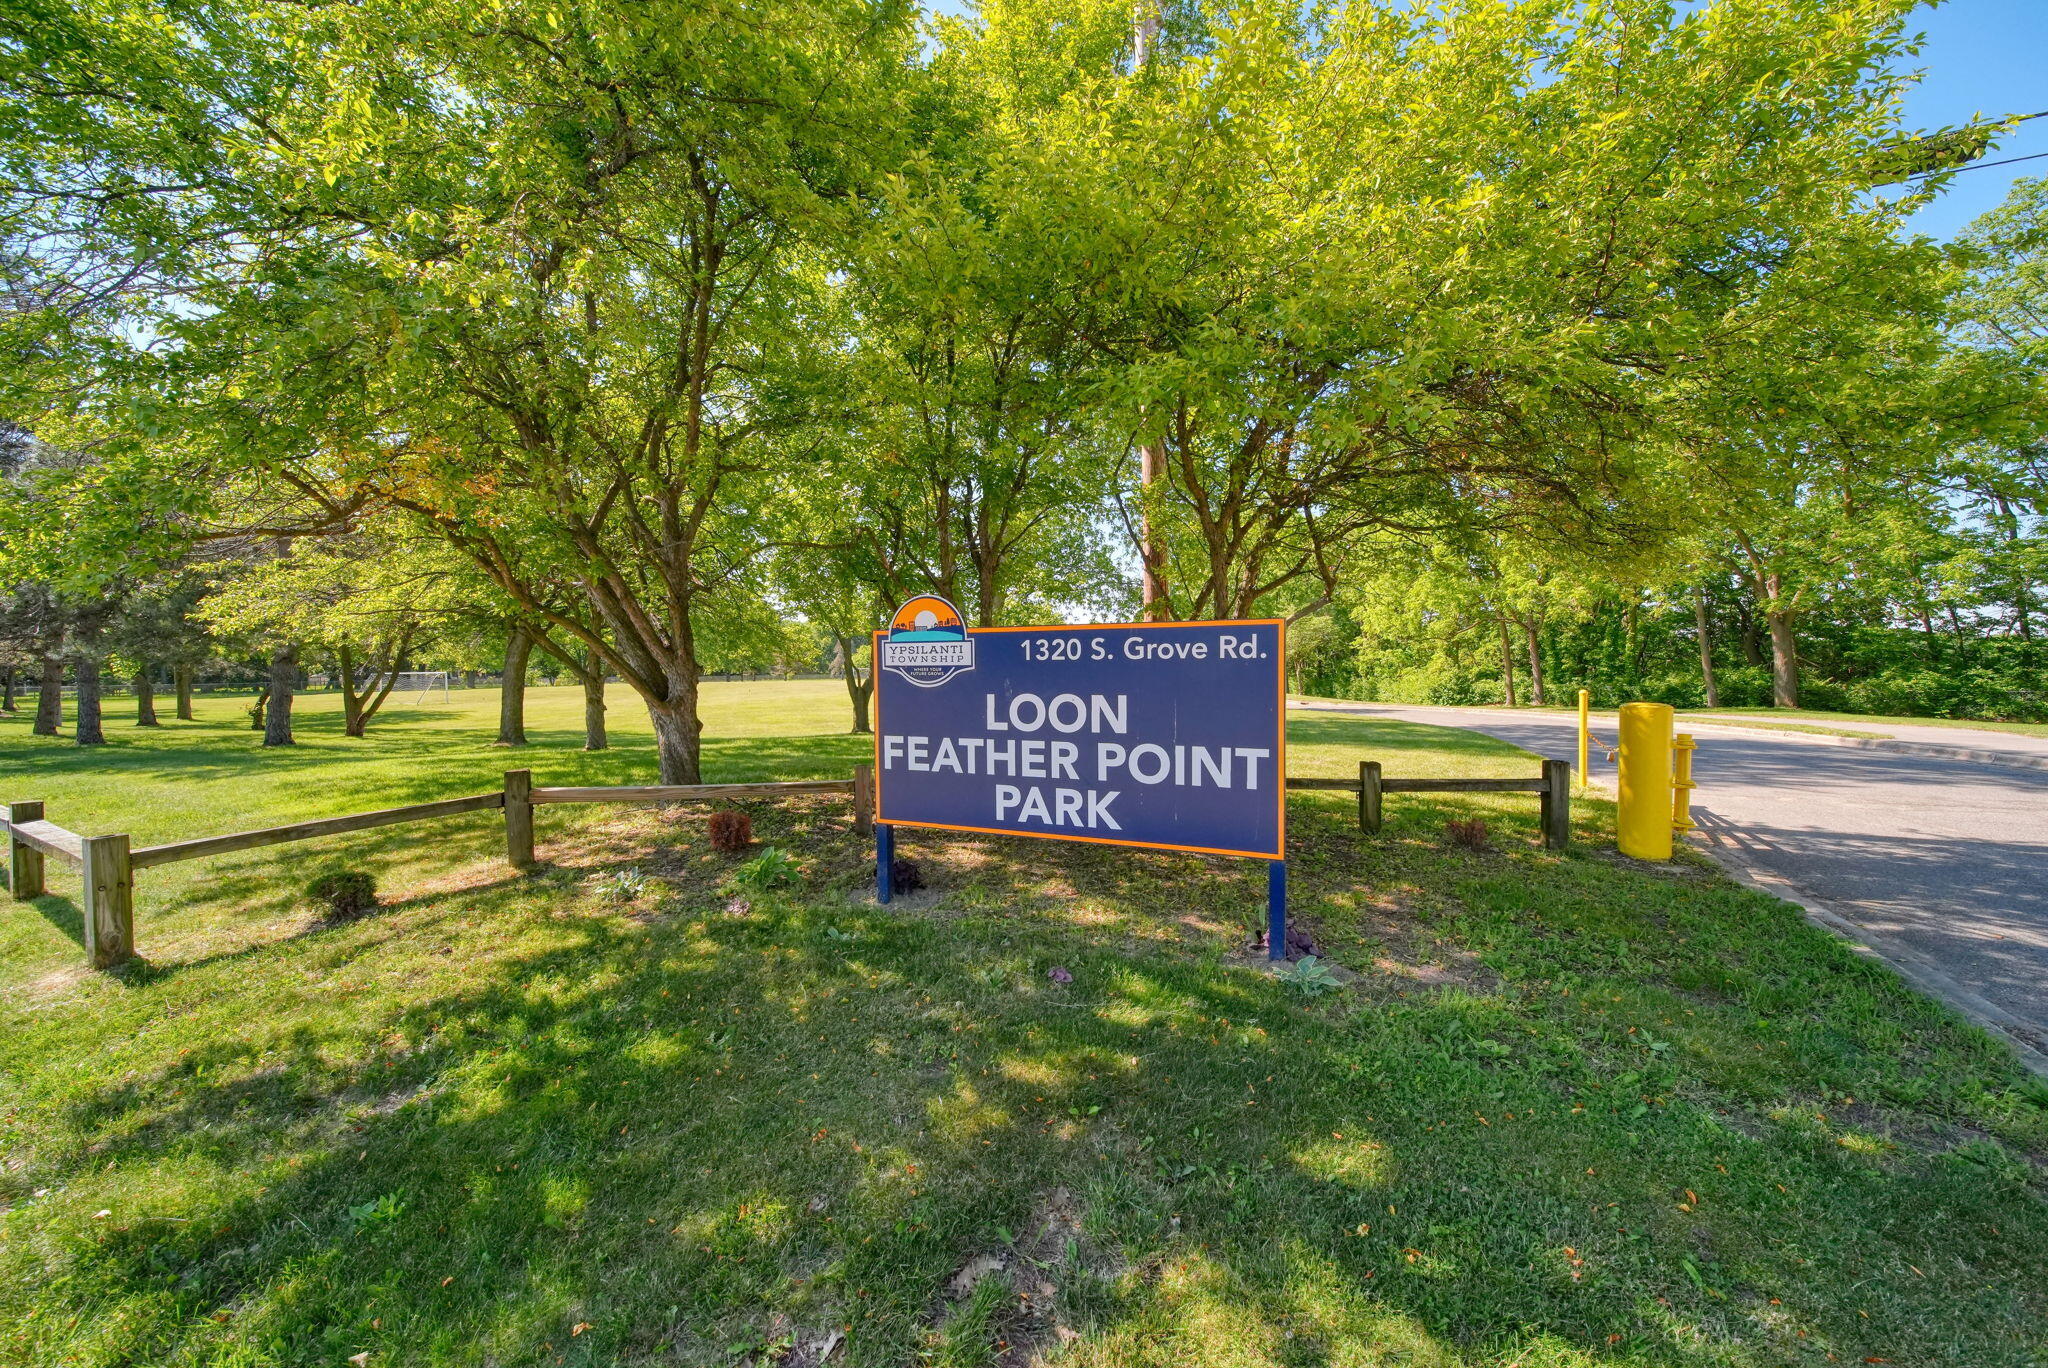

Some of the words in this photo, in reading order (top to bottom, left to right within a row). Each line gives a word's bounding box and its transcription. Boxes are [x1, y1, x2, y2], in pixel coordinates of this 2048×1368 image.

[889, 655, 964, 663] TOWNSHIP
[890, 645, 964, 654] YPSILANTI
[1020, 638, 1082, 662] 1320
[1090, 637, 1113, 660] S.
[1124, 636, 1208, 660] Grove
[1219, 633, 1268, 660] Rd.
[986, 693, 1128, 734] LOON
[883, 735, 1080, 780] FEATHER
[1098, 742, 1270, 790] POINT
[995, 784, 1123, 830] PARK
